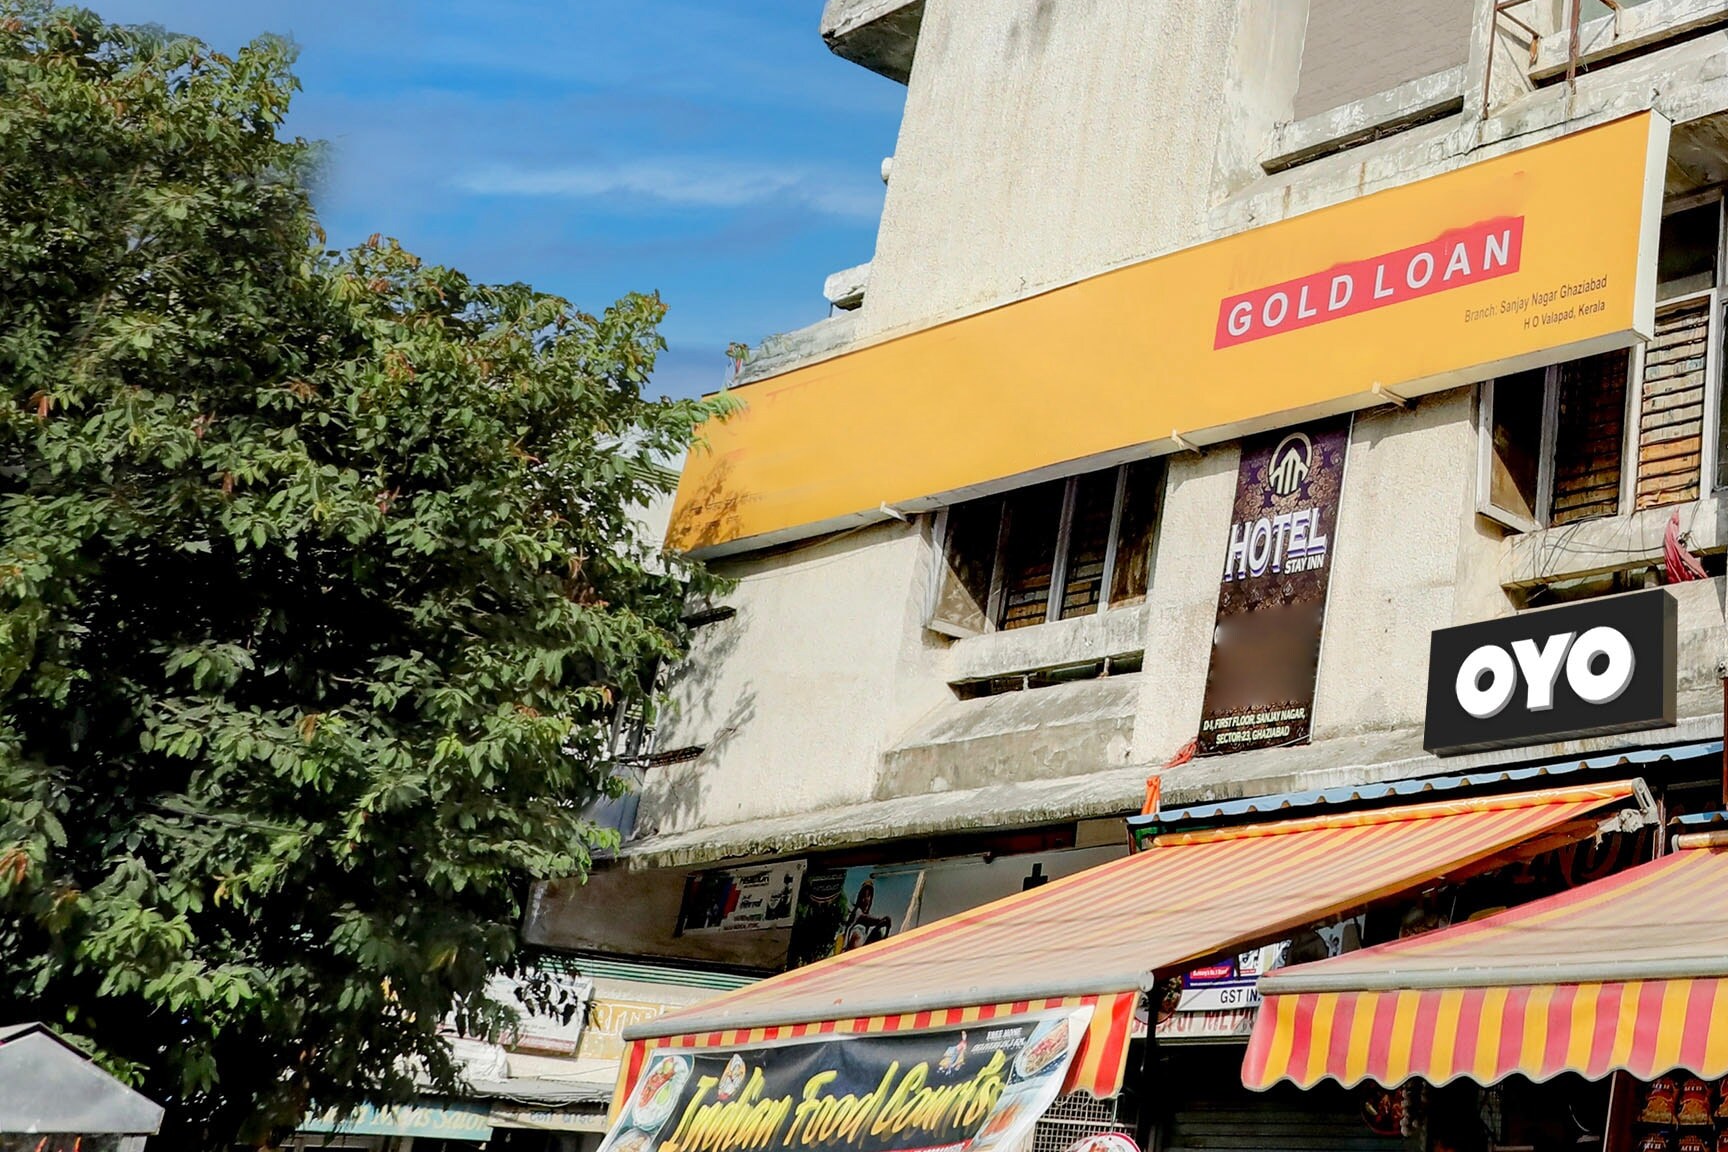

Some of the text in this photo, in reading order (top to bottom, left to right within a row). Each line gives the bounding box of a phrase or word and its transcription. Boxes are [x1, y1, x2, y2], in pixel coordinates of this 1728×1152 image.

[1227, 229, 1511, 338] GOLD LOAN
[1464, 275, 1607, 323] Branch: Sanjay Nagar Ghaziabad
[1524, 319, 1530, 330] H
[1542, 307, 1576, 325] Valapad,
[1578, 300, 1605, 317] Kerala
[1224, 508, 1328, 582] HOTEL
[1284, 554, 1325, 575] STAY INN
[1454, 625, 1636, 719] OYO
[1214, 717, 1233, 729] FIRST
[1256, 711, 1283, 724] SANJAY
[1252, 725, 1290, 740] GHAZIABAD
[1220, 989, 1243, 1004] GST
[660, 1065, 793, 1152] Indian
[784, 1060, 899, 1146] Food
